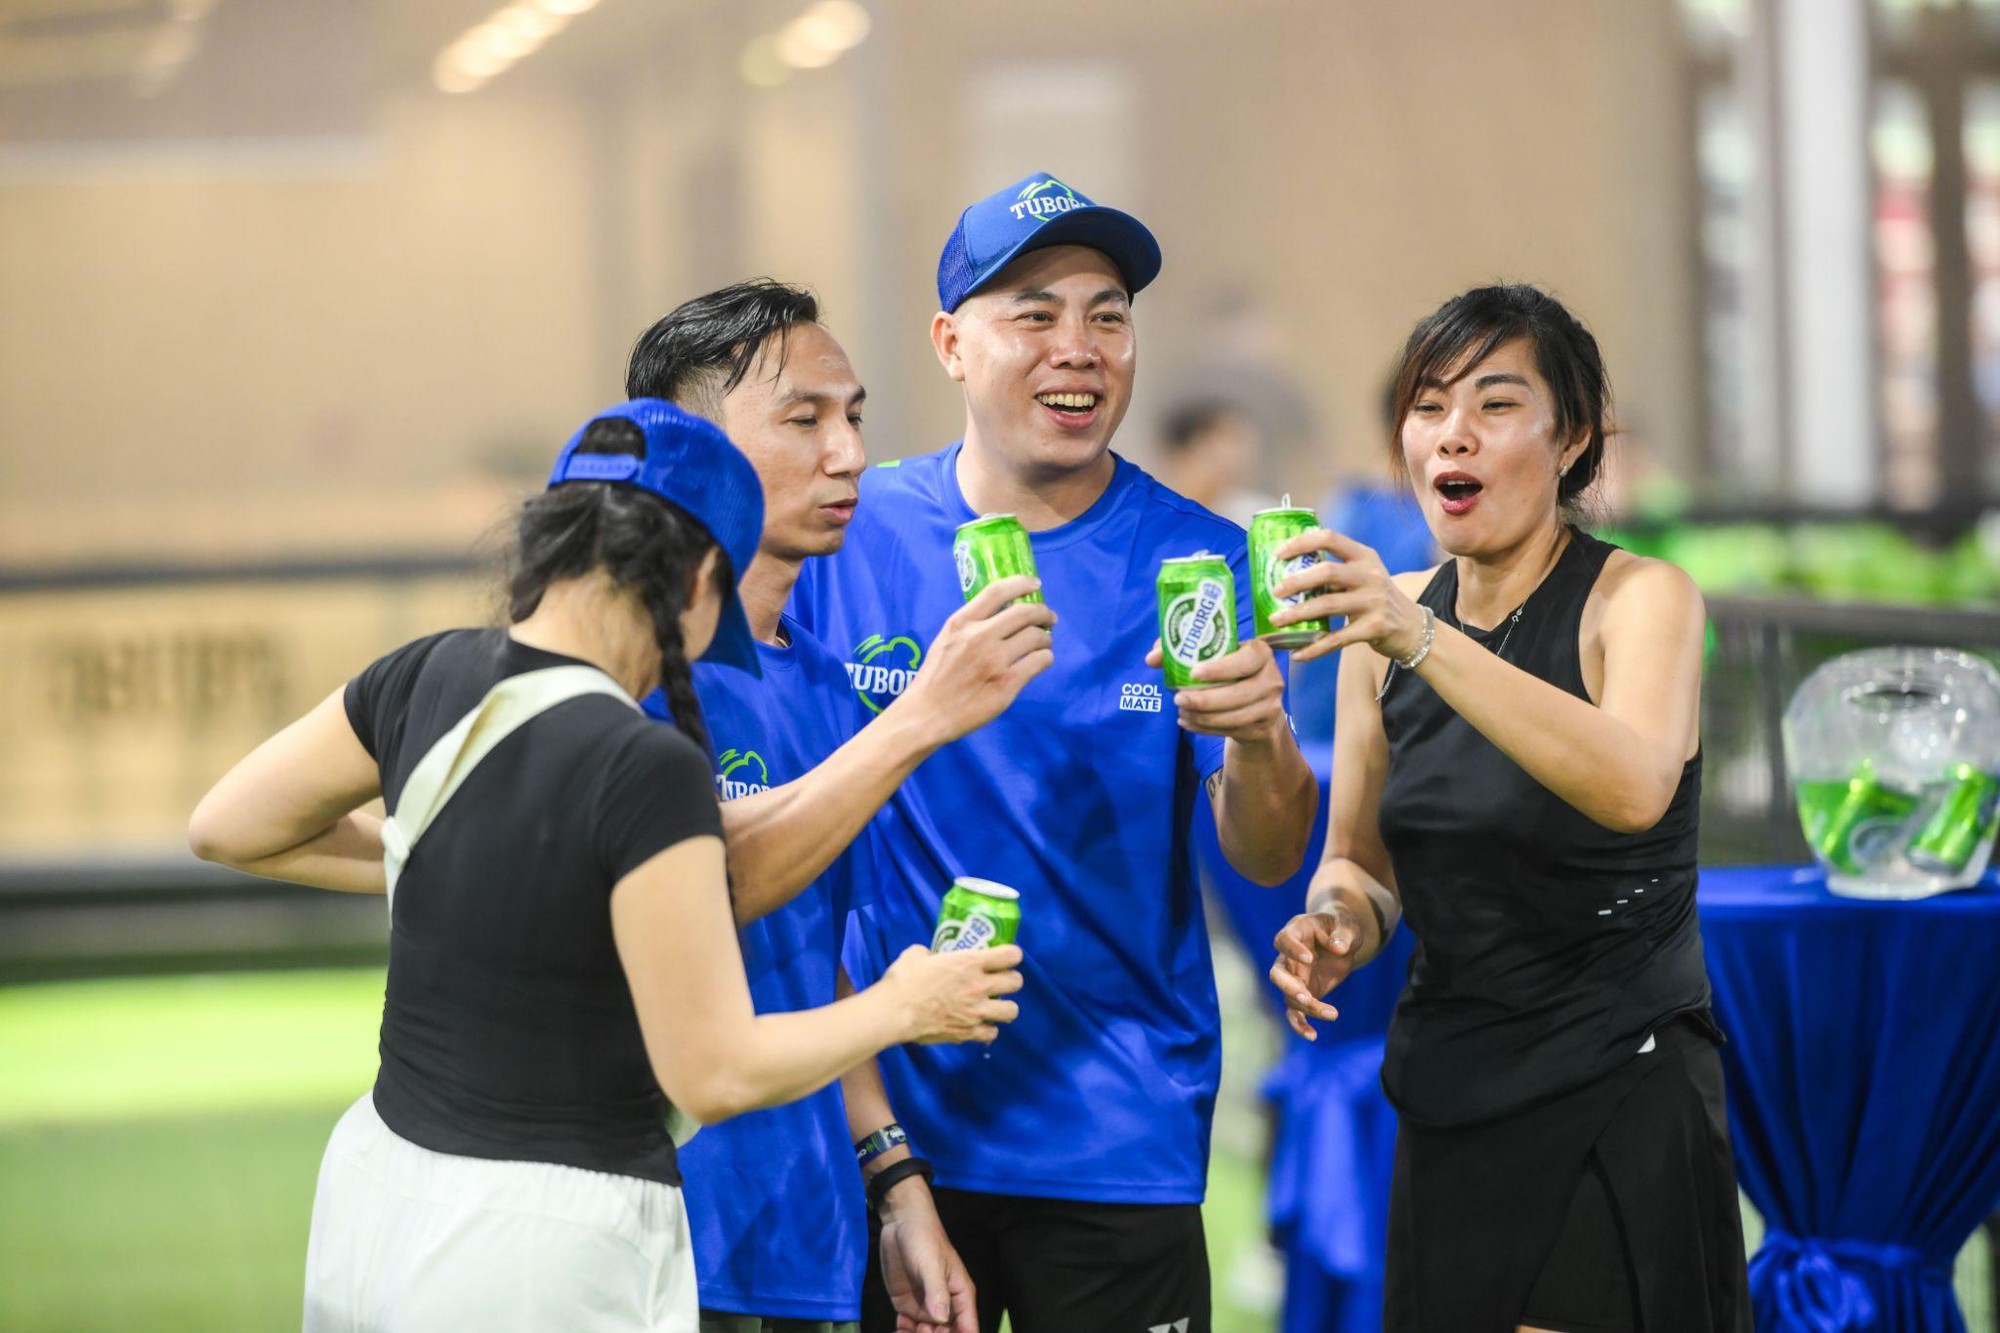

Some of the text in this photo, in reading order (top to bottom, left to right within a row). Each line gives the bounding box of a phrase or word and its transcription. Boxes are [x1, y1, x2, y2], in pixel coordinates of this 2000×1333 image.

[1010, 196, 1088, 219] TUBOR
[1179, 598, 1216, 659] TUBORG
[1122, 683, 1162, 697] COOL
[1121, 697, 1160, 710] MATE
